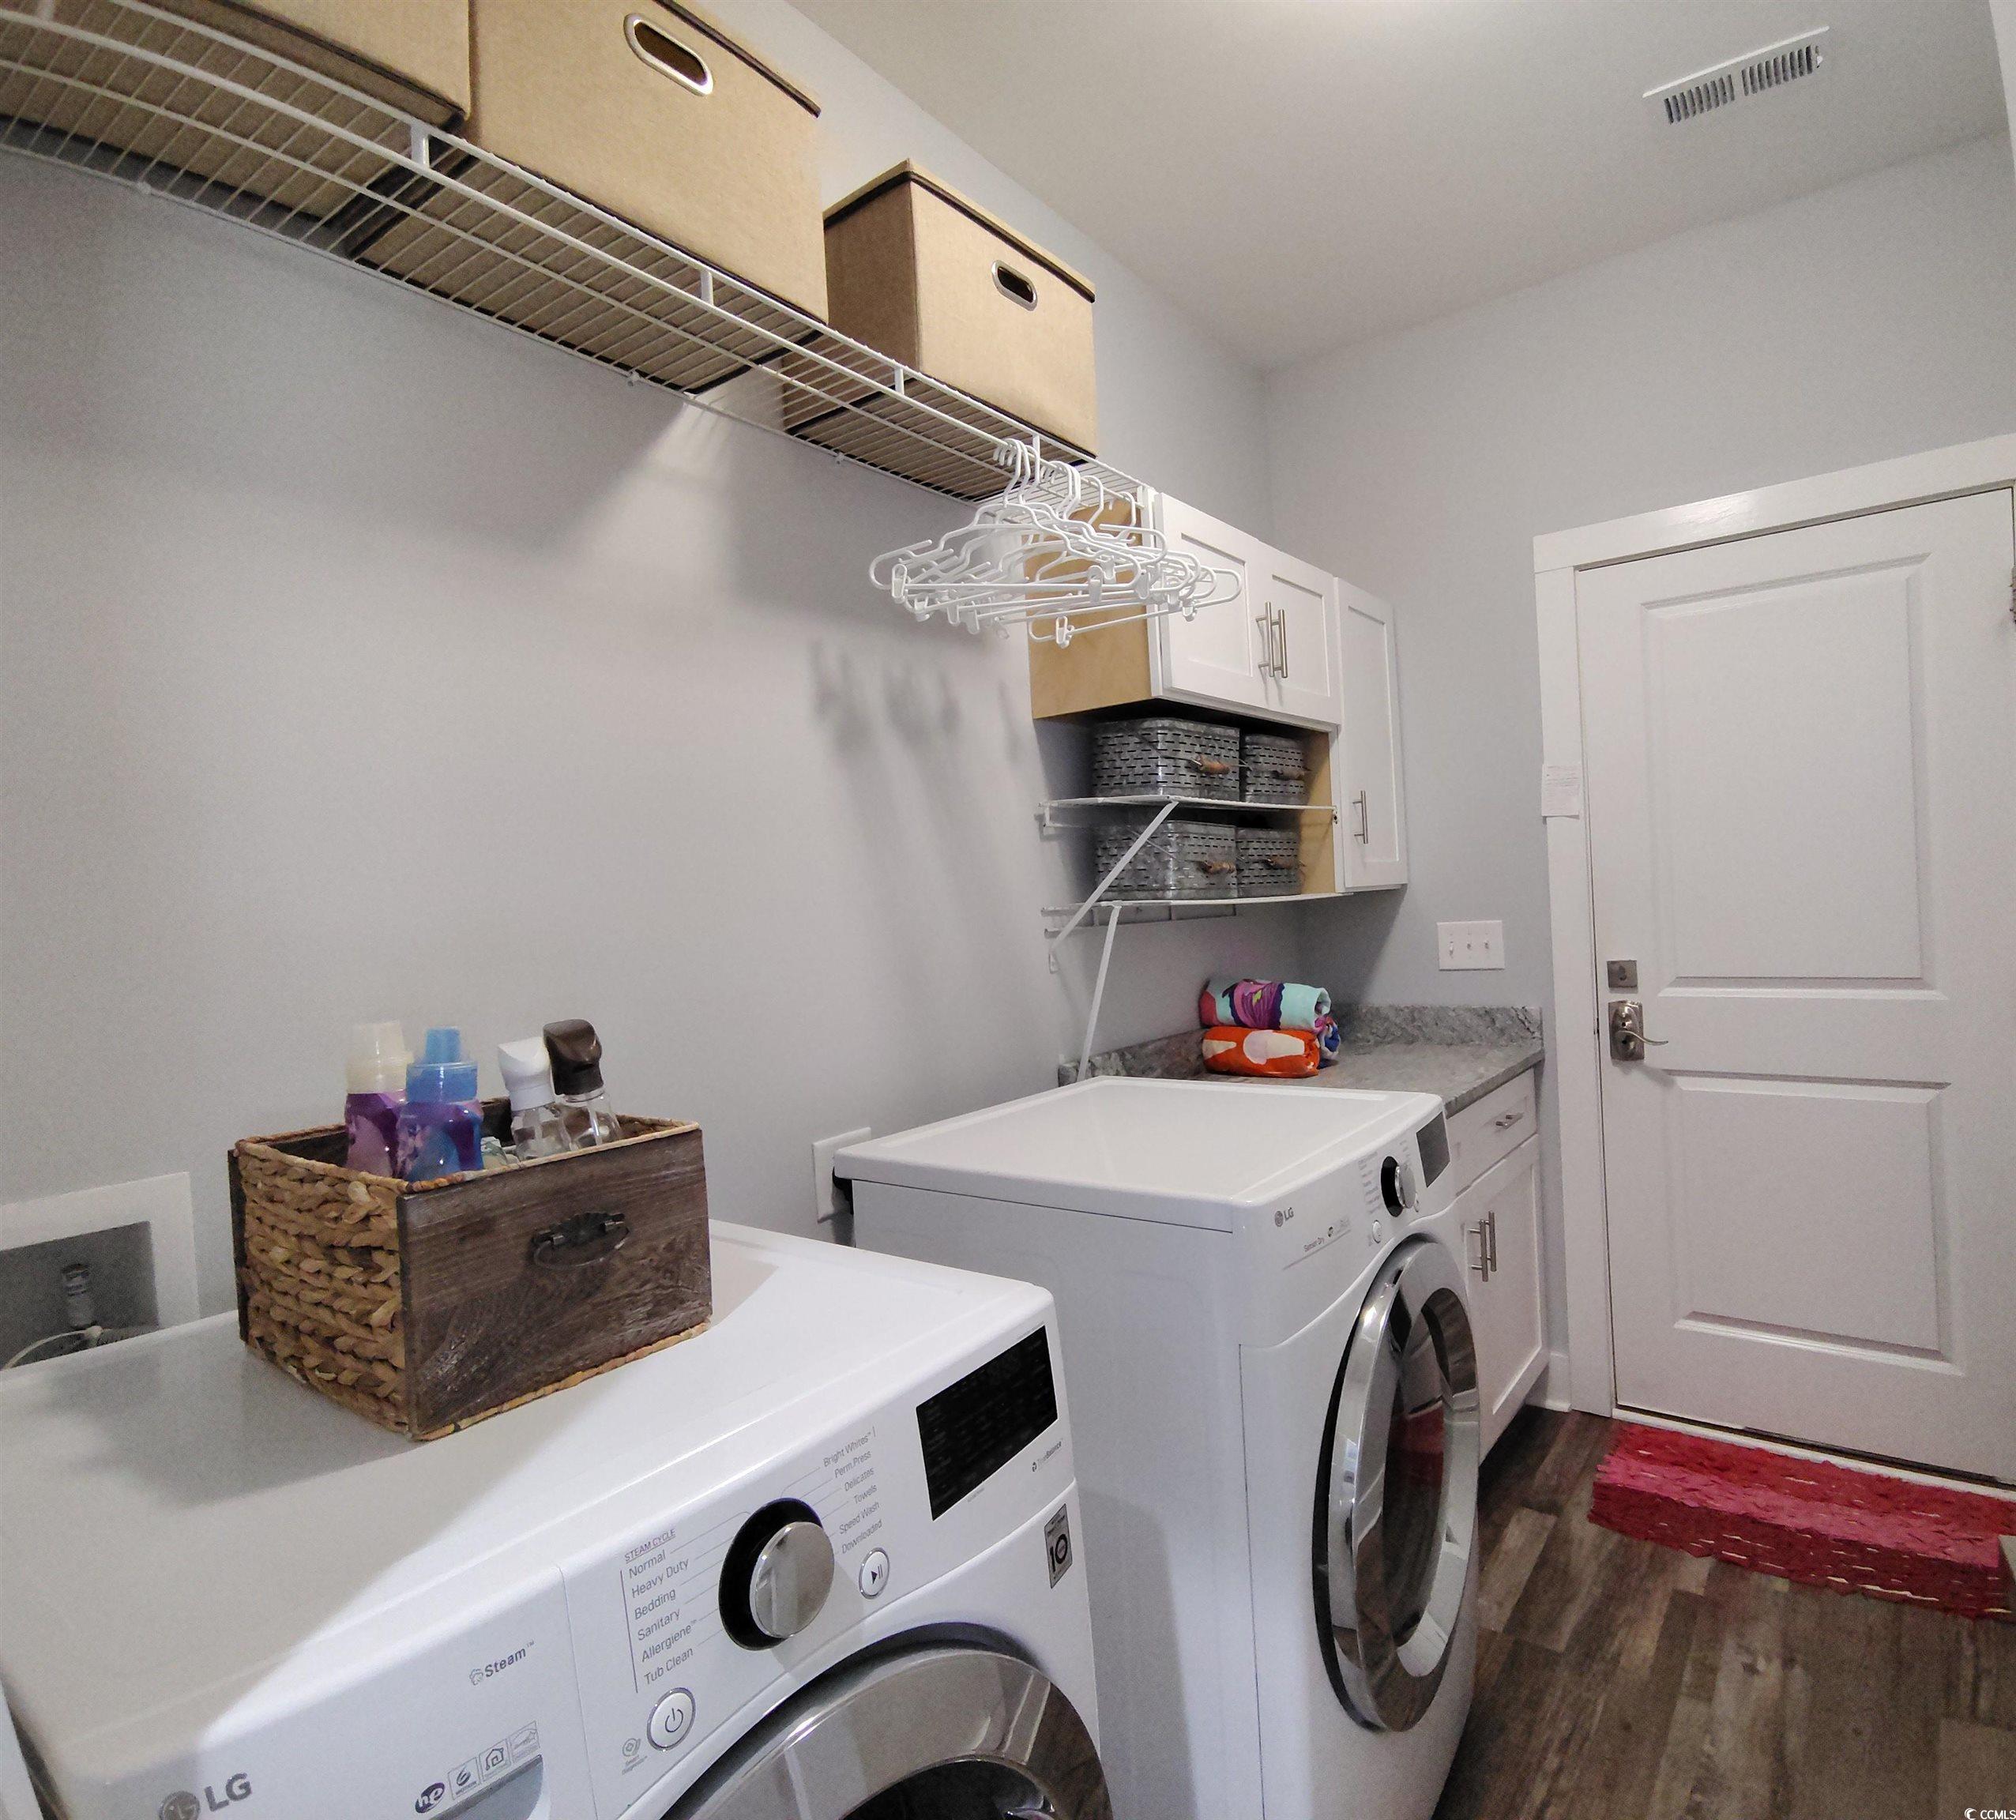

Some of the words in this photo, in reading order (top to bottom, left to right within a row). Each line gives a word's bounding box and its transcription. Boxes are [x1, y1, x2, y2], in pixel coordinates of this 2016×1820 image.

[1283, 1207, 1294, 1221] LG
[823, 1449, 844, 1467] Bright
[844, 1468, 874, 1491] Delicates
[854, 1484, 877, 1504] Towels
[839, 1514, 860, 1534] Speed
[860, 1502, 880, 1518] Wash
[624, 1542, 651, 1562] STEAM
[653, 1529, 676, 1546] CYCLE
[841, 1520, 882, 1554] Downloaded
[629, 1550, 666, 1578] Normal
[631, 1574, 664, 1598] Heavy
[666, 1559, 689, 1578] Duty
[634, 1589, 675, 1620] Bedding
[638, 1608, 680, 1641] Sanitary
[644, 1667, 664, 1685] Tub
[666, 1648, 694, 1671] Clean
[205, 1773, 252, 1812] LG
